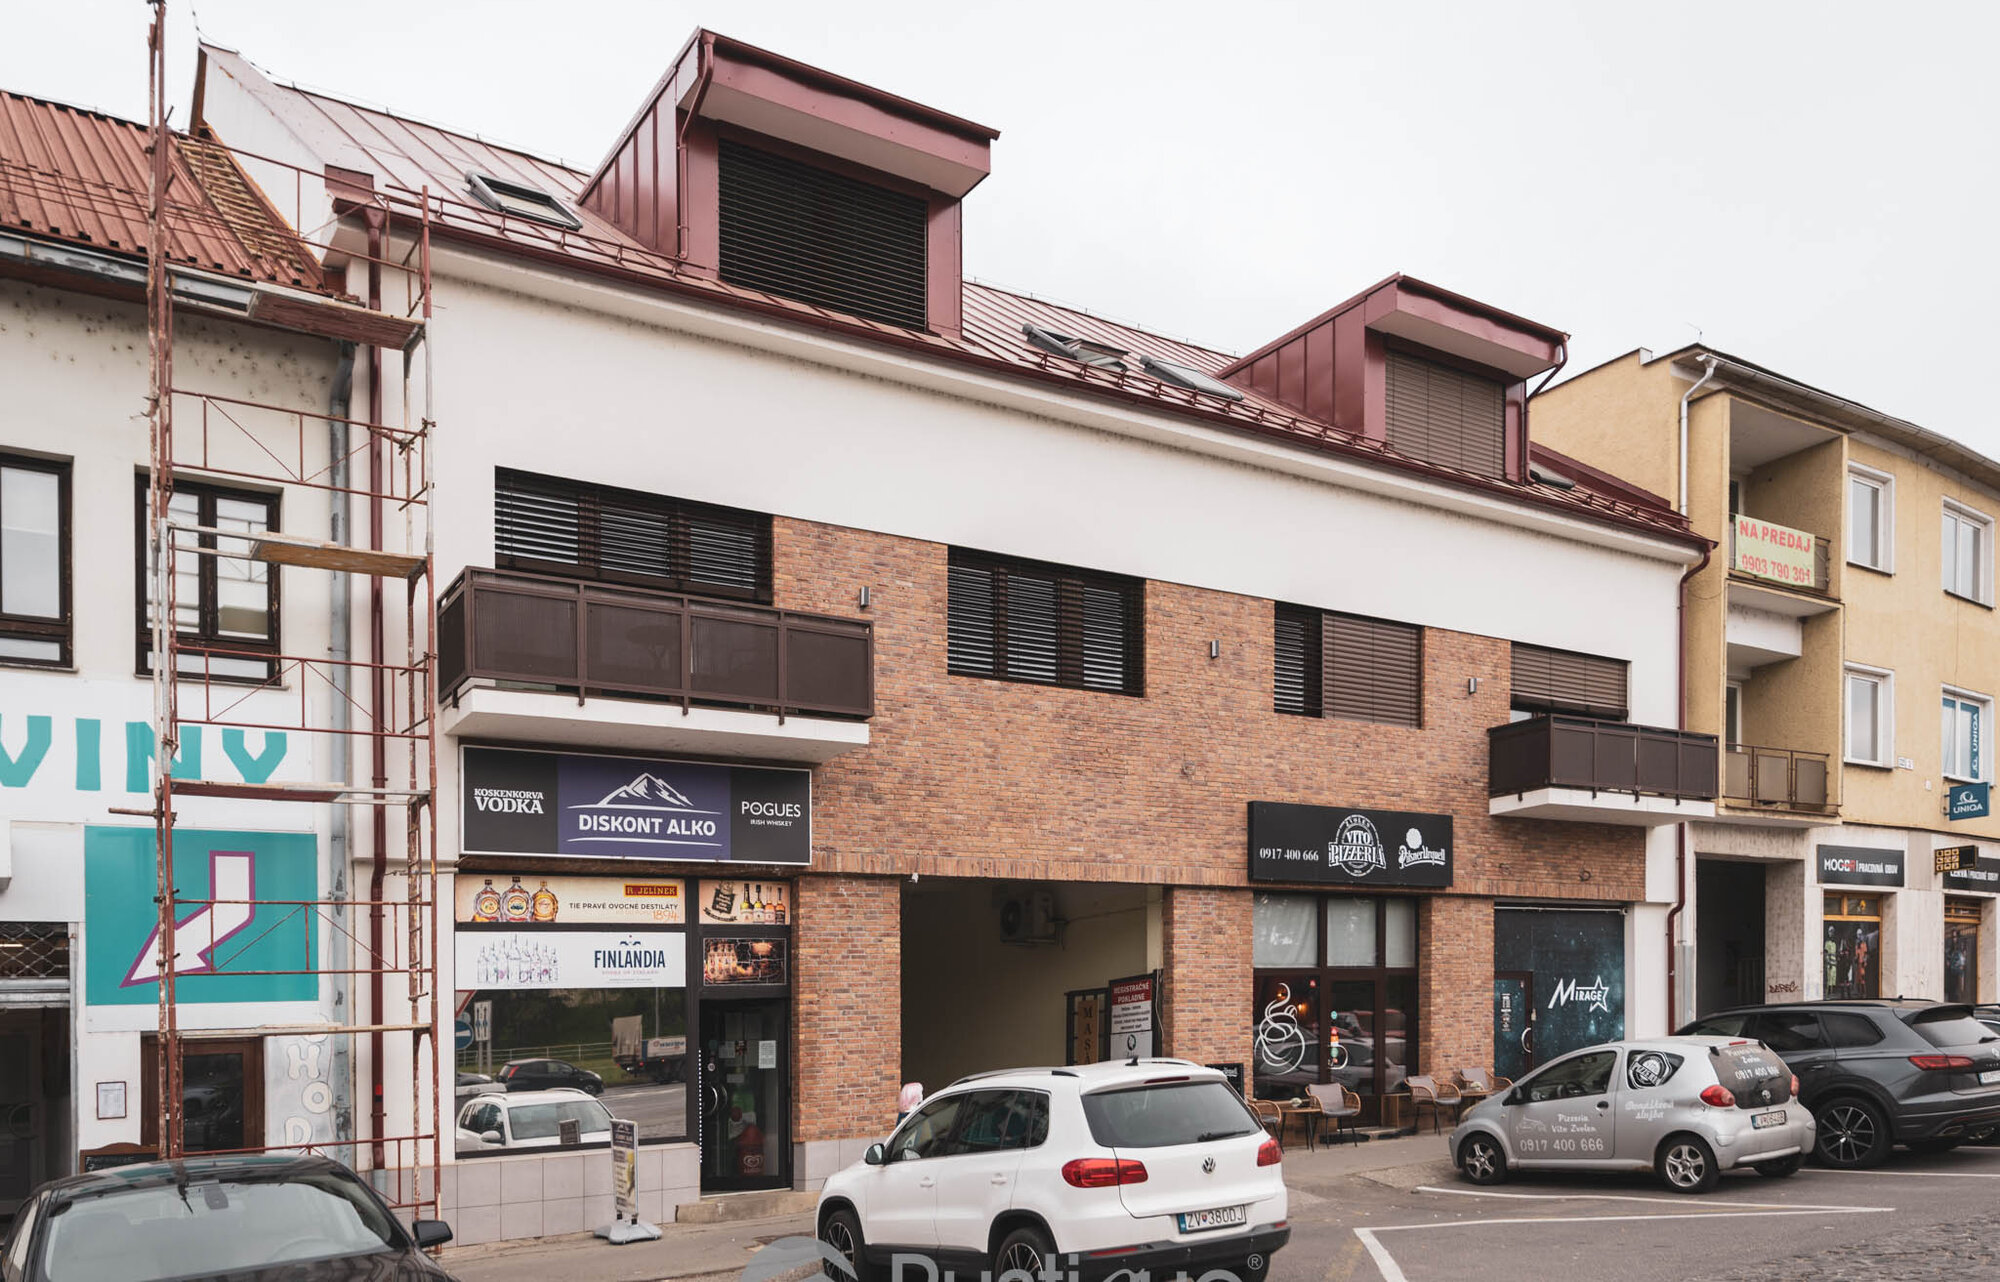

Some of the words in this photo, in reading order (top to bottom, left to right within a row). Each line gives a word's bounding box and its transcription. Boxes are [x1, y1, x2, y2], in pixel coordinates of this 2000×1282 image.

[1739, 520, 1758, 540] NA
[1761, 526, 1811, 552] PREDAJ
[1742, 553, 1768, 575] 0903
[1771, 560, 1790, 580] 790
[474, 788, 544, 800] KOSKENKORVA
[474, 796, 545, 814] VODKA
[741, 801, 802, 818] POGUES
[1953, 803, 1983, 814] UNIQA
[578, 814, 663, 834] DISKONT
[666, 818, 716, 836] ALKO
[766, 819, 793, 827] WHISKEY
[1346, 830, 1371, 845] VITO
[1259, 848, 1282, 860] 0917
[1284, 849, 1301, 861] 400
[1302, 850, 1319, 862] 666
[1330, 844, 1384, 866] PIZZERIA
[594, 950, 666, 968] FINLANDIA
[1547, 977, 1603, 1009] MIRAGE
[1734, 1069, 1753, 1080] 0917
[1520, 1139, 1548, 1151] 0917
[1553, 1139, 1576, 1151] 400
[1580, 1138, 1604, 1151] 666
